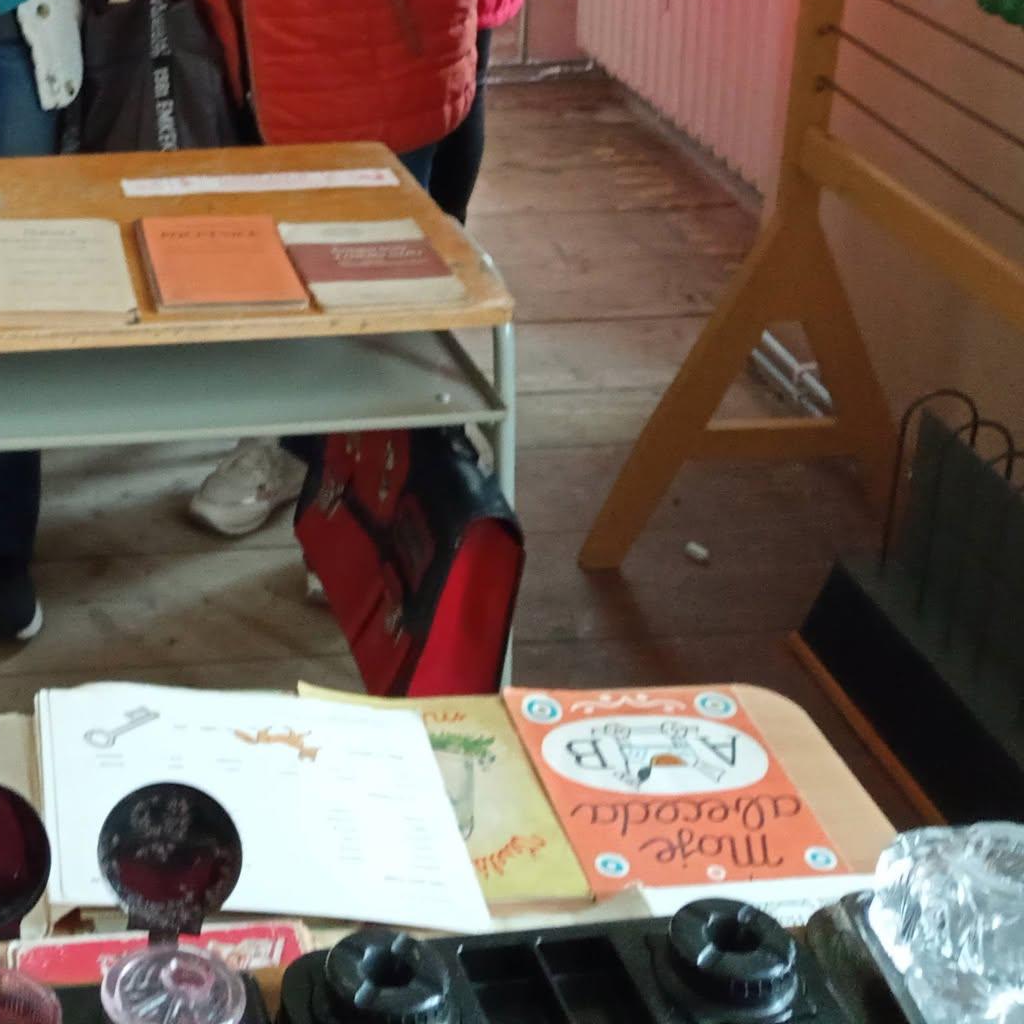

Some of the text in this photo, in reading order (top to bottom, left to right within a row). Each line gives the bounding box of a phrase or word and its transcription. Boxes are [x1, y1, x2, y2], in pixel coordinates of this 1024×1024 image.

[566, 739, 612, 770] B
[697, 735, 738, 767] A
[638, 828, 784, 869] Moje
